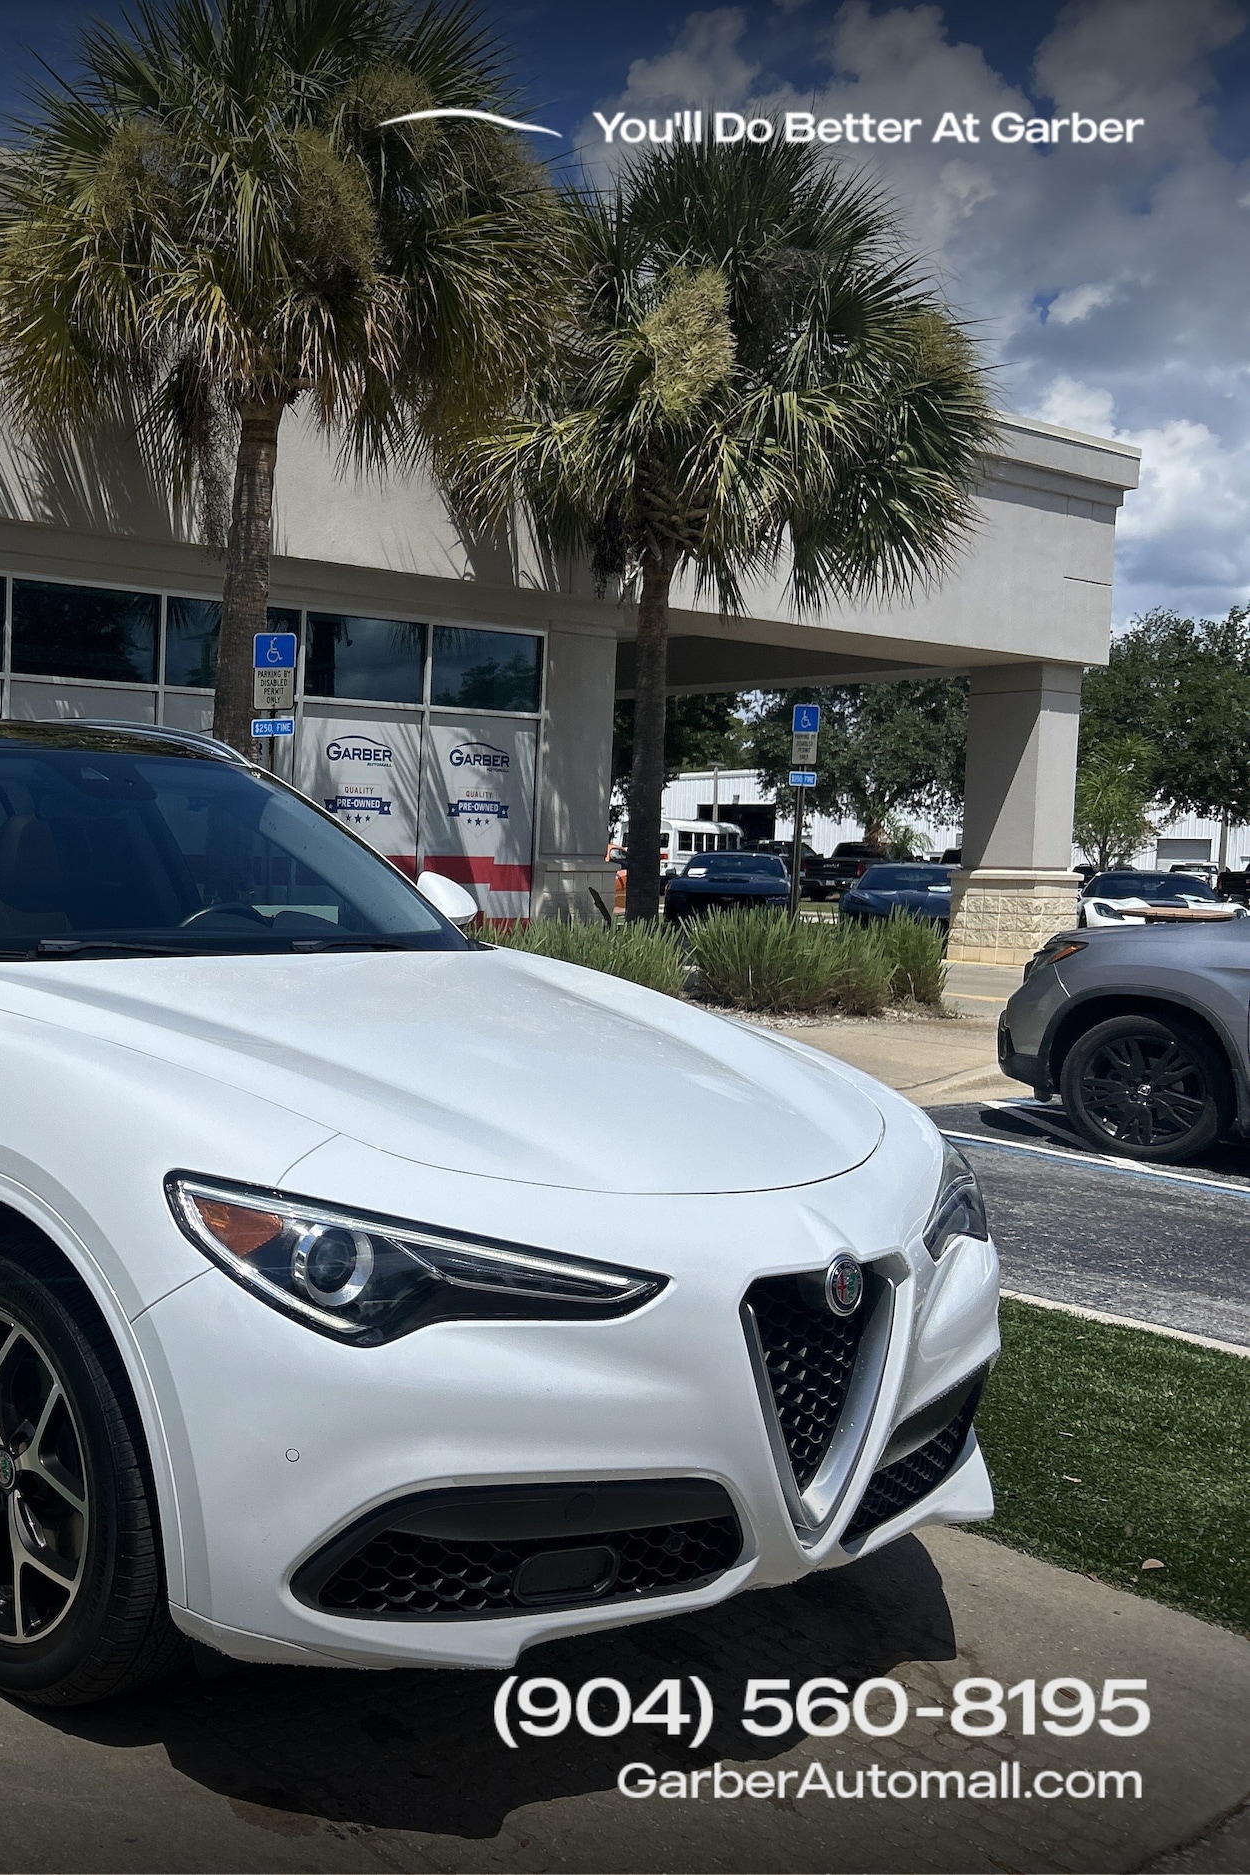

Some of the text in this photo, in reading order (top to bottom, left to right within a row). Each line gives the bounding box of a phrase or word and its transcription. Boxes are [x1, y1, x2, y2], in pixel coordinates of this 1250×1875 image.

[257, 670, 291, 678] PARKING BY
[260, 679, 288, 687] DISABLED
[263, 687, 284, 696] PERMIT
[266, 696, 281, 704] ONLY
[254, 722, 291, 734] $250 FINE
[326, 743, 393, 762] GARBER
[449, 749, 510, 768] GARBER
[344, 786, 374, 795] QUALITY
[465, 790, 493, 799] QUALITY
[336, 798, 381, 809] PRE-OWNED
[458, 802, 499, 812] PRE-OWNED
